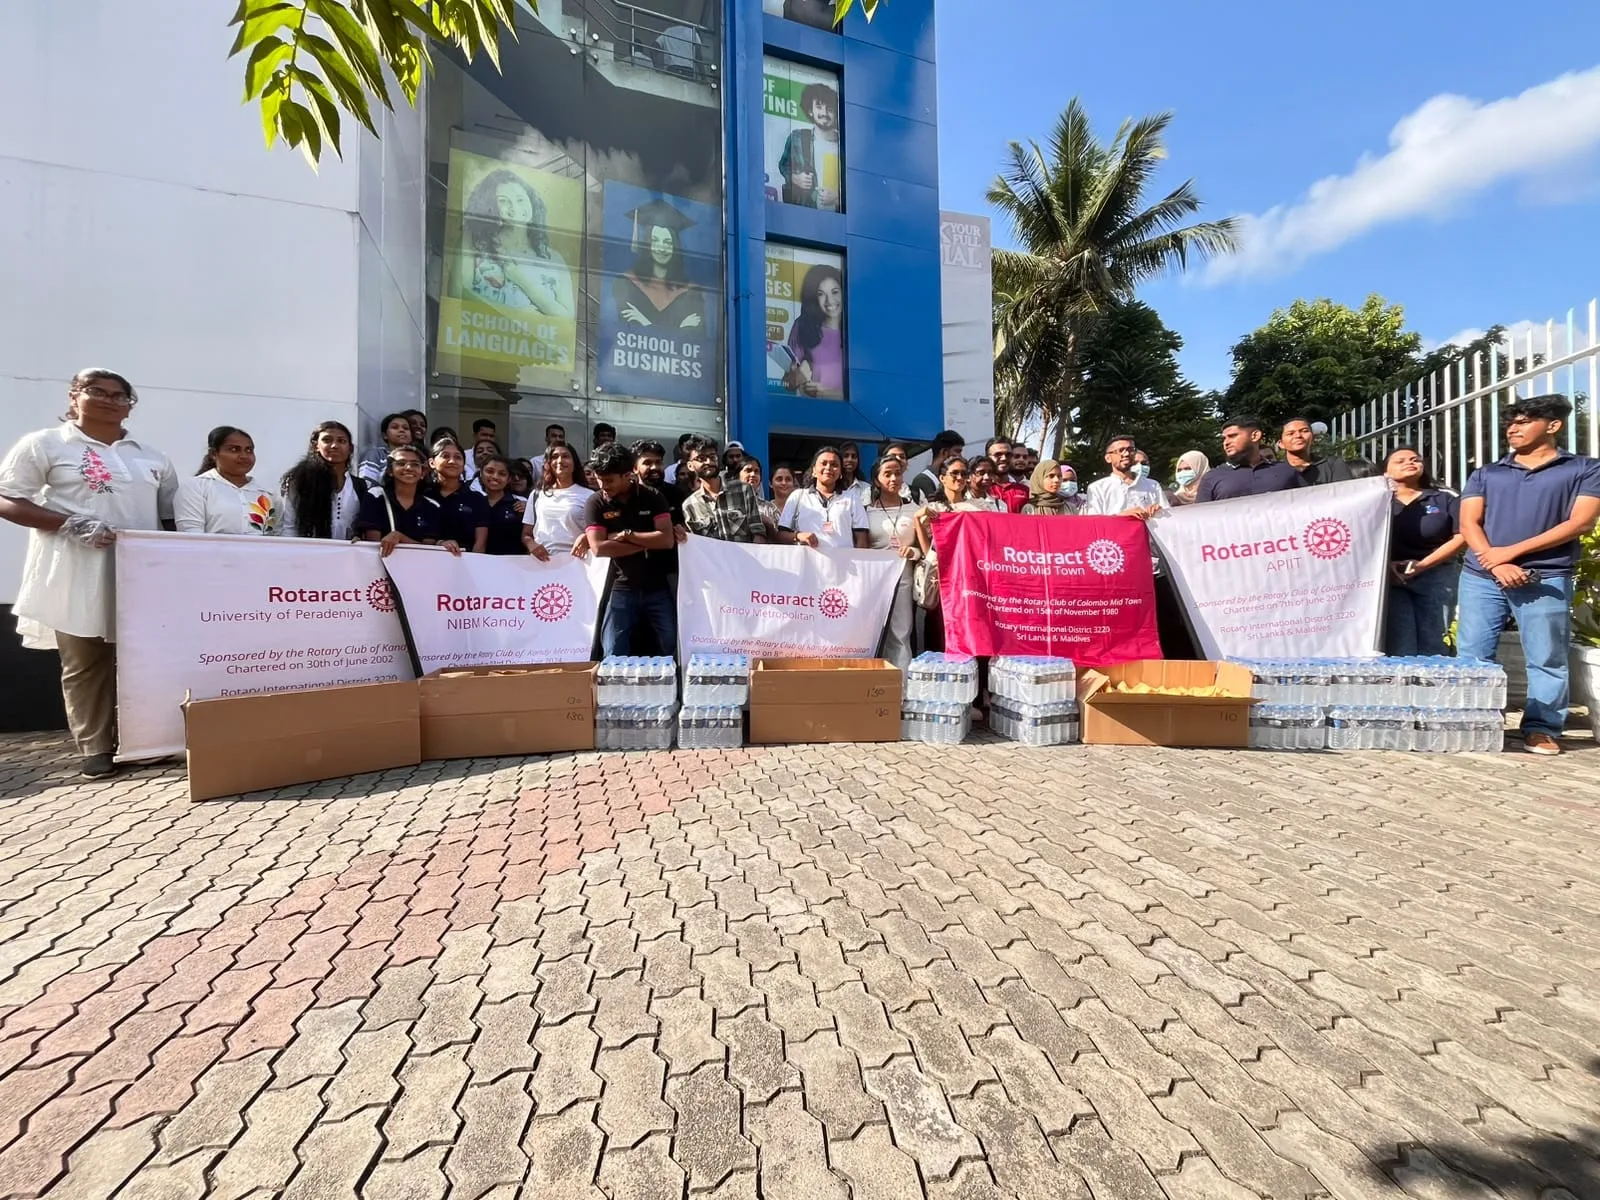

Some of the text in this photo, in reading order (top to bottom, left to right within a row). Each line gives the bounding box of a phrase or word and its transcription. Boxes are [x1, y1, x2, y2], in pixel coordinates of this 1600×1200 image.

[951, 223, 981, 237] YOUR
[462, 310, 558, 340] SCHOOL OF
[445, 326, 569, 365] LANGUAGES
[616, 331, 700, 358] SCHOOL OF
[614, 349, 702, 379] BUSINESS
[1003, 546, 1083, 565] Rotaract
[1201, 535, 1299, 562] Rotaract
[976, 560, 1085, 576] Colombo Mid Town
[1266, 557, 1301, 573] APIIT
[269, 586, 362, 603] Rotaract
[437, 594, 526, 611] Rotaract
[751, 590, 815, 608] Rotaract
[998, 596, 1008, 604] by
[1023, 598, 1048, 606] Rotary
[1049, 598, 1067, 606] Club
[1077, 599, 1109, 607] Colombo
[1237, 597, 1248, 605] by
[1263, 591, 1288, 600] Rotary
[1311, 587, 1320, 596] of
[200, 609, 363, 623] University of Peradeniya
[720, 605, 815, 621] Kandy Metropolitan
[986, 602, 1022, 613] Chartered
[1063, 608, 1100, 616] November
[447, 616, 525, 630] NIBM Kandy
[995, 620, 1018, 632] Rotary
[1020, 624, 1067, 633] International
[1068, 626, 1092, 634] District
[1220, 611, 1356, 633] Rotary International District 3220
[1016, 633, 1027, 641] Sri
[1028, 634, 1051, 642] Lanka
[1060, 635, 1090, 643] Maldives
[1260, 629, 1285, 639] Lanka
[1295, 625, 1331, 635] Maldives
[722, 646, 760, 655] Chartered
[730, 638, 740, 646] by
[756, 640, 779, 648] Rotary
[797, 643, 805, 651] of
[198, 643, 409, 665] Sponsored by the Rotary Club of Kand
[452, 652, 463, 661] by
[495, 648, 514, 657] Club
[515, 648, 525, 658] of
[226, 655, 394, 674] Chartered on 30th of June 2002
